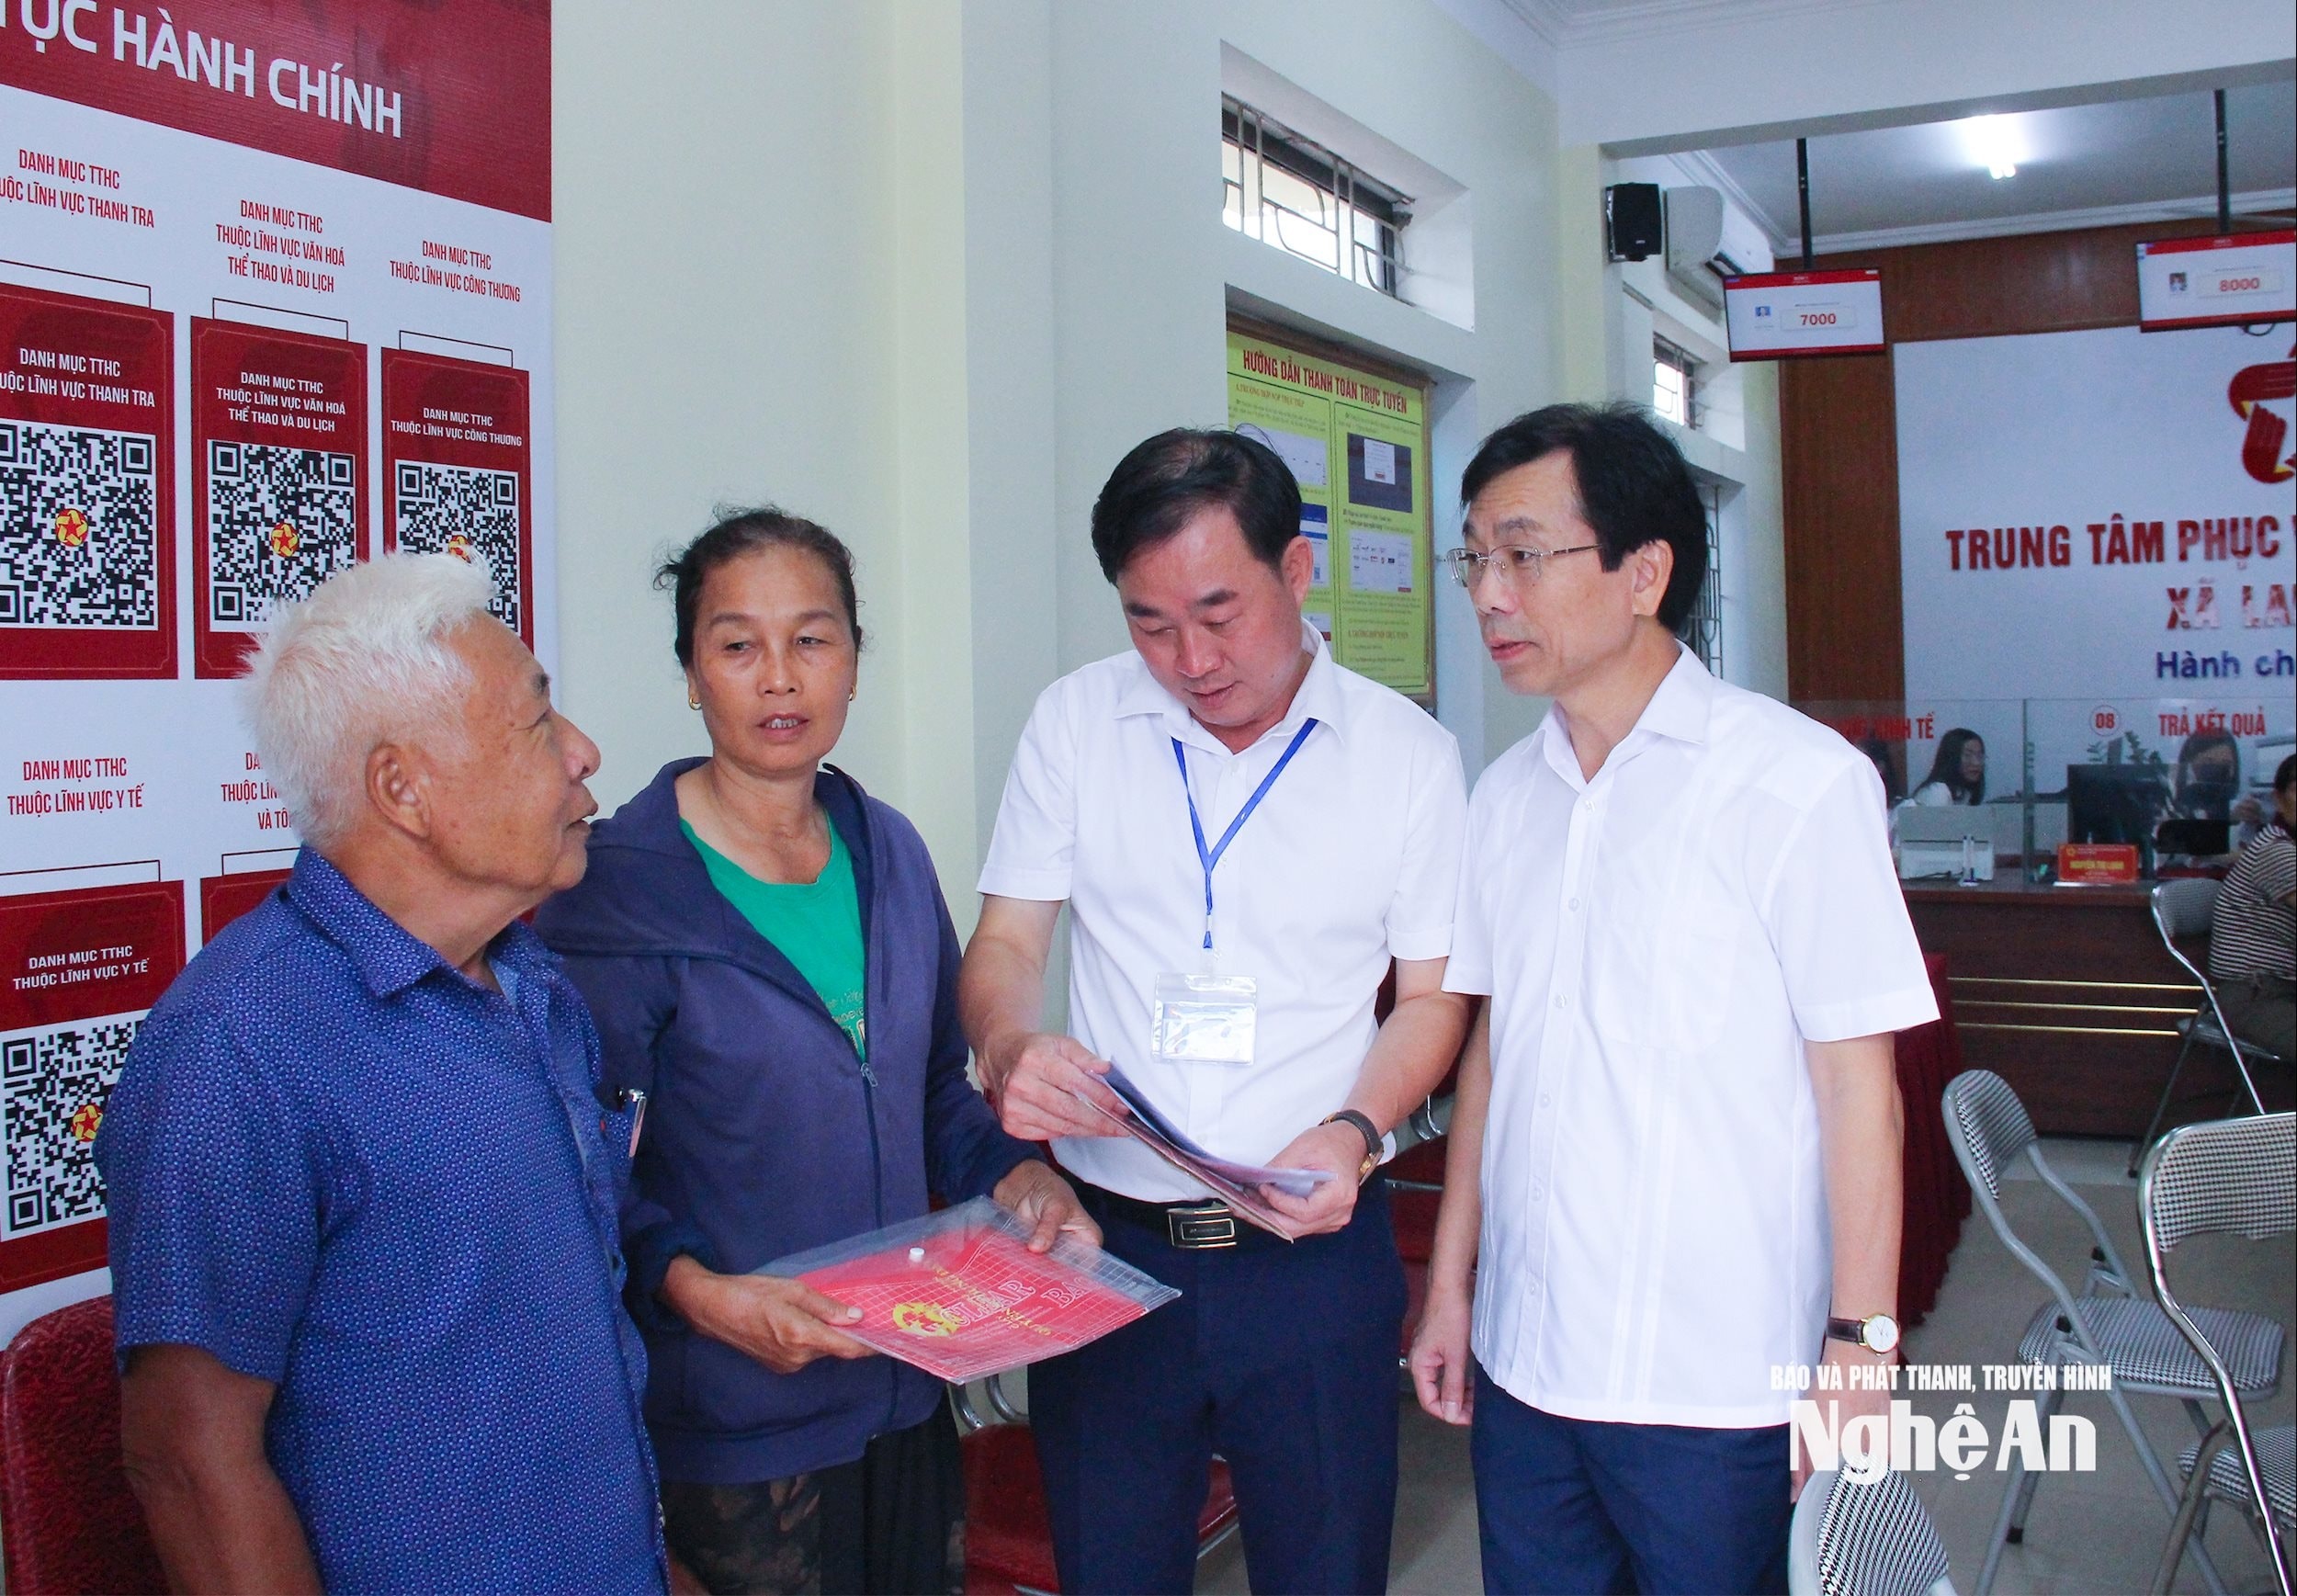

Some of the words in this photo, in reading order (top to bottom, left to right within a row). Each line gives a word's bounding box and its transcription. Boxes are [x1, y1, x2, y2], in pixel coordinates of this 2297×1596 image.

[0, 0, 97, 53] ỤC
[114, 7, 255, 98] HÀNH
[268, 59, 402, 138] CHÍNH
[19, 149, 54, 175] DANH
[59, 158, 85, 184] MỤC
[89, 164, 120, 189] TTHC
[28, 182, 57, 208] LĨNH
[60, 190, 85, 215] VỰC
[87, 196, 129, 222] THANH
[132, 206, 154, 228] TRA
[241, 199, 269, 222] DANH
[272, 207, 295, 230] MỤC
[297, 212, 323, 233] TTHC
[216, 223, 251, 250] THUỘC
[254, 230, 277, 253] LĨNH
[280, 237, 300, 260] VỰC
[302, 241, 322, 262] VĂN
[325, 246, 345, 266] HOÁ
[423, 241, 447, 261] DANH
[449, 246, 468, 267] MỤC
[470, 251, 492, 270] TTHC
[228, 253, 249, 277] THỂ
[251, 260, 277, 282] THAO
[280, 264, 294, 285] VÀ
[297, 269, 310, 289] DU
[312, 273, 334, 294] LỊCH
[390, 260, 420, 284] THUỘC
[423, 265, 442, 287] LĨNH
[445, 272, 461, 292] VỰC
[463, 274, 486, 295] CÔNG
[488, 281, 521, 302] THƯƠNG
[2220, 277, 2260, 292] 8000
[1800, 312, 1837, 325] 7000
[19, 347, 55, 368] DANH
[59, 354, 86, 375] MỤC
[89, 357, 121, 378] TTHC
[28, 374, 57, 395] LĨNH
[61, 380, 85, 401] VỰC
[88, 383, 130, 404] THANH
[132, 390, 155, 407] TRA
[241, 371, 270, 387] DANH
[273, 376, 295, 392] MỤC
[298, 379, 323, 394] TTHC
[1303, 368, 1333, 393] THANH
[1335, 375, 1358, 400] TOÁN
[1360, 383, 1381, 410] TRỰC
[216, 387, 252, 404] THUỘC
[254, 391, 278, 407] LĨNH
[280, 395, 301, 412] VỰC
[303, 398, 323, 413] VĂN
[325, 401, 346, 415] HOÁ
[423, 407, 448, 421] DANH
[449, 411, 470, 425] MỤC
[470, 413, 493, 426] TTHC
[228, 405, 250, 422] THỂ
[251, 411, 278, 425] THAO
[281, 413, 295, 427] VÀ
[297, 416, 311, 429] DU
[312, 418, 335, 433] LỊCH
[390, 420, 422, 436] THUỘC
[423, 423, 444, 437] LĨNH
[445, 427, 463, 441] VỰC
[464, 428, 488, 443] CÔNG
[1945, 525, 2071, 571] TRUNG
[2087, 513, 2165, 565] TÂM
[2177, 515, 2280, 571] PHỤC
[2167, 576, 2220, 630] XÃ
[2156, 650, 2240, 678] Hành
[1916, 711, 1934, 739] TẾ
[2096, 713, 2115, 730] 08
[2158, 706, 2190, 736] TRẢ
[2231, 706, 2266, 738] QUẢ
[23, 760, 60, 781] DANH
[63, 759, 92, 783] MỤC
[95, 757, 127, 777] TTHC
[7, 790, 51, 818] THUỘC
[55, 789, 85, 812] LĨNH
[88, 790, 113, 814] VỰC
[116, 789, 125, 809] Y
[128, 783, 144, 808] TẾ
[221, 779, 257, 805] THUỘC
[257, 808, 272, 830] VÀ
[28, 954, 66, 969] DANH
[69, 949, 98, 965] MỤC
[100, 945, 133, 960] TTHC
[13, 973, 58, 990] THUỘC
[61, 969, 90, 984] LĨNH
[93, 965, 119, 980] VỰC
[121, 964, 130, 976] Y
[132, 957, 150, 973] TẾ
[941, 1280, 1036, 1327] CLEAR
